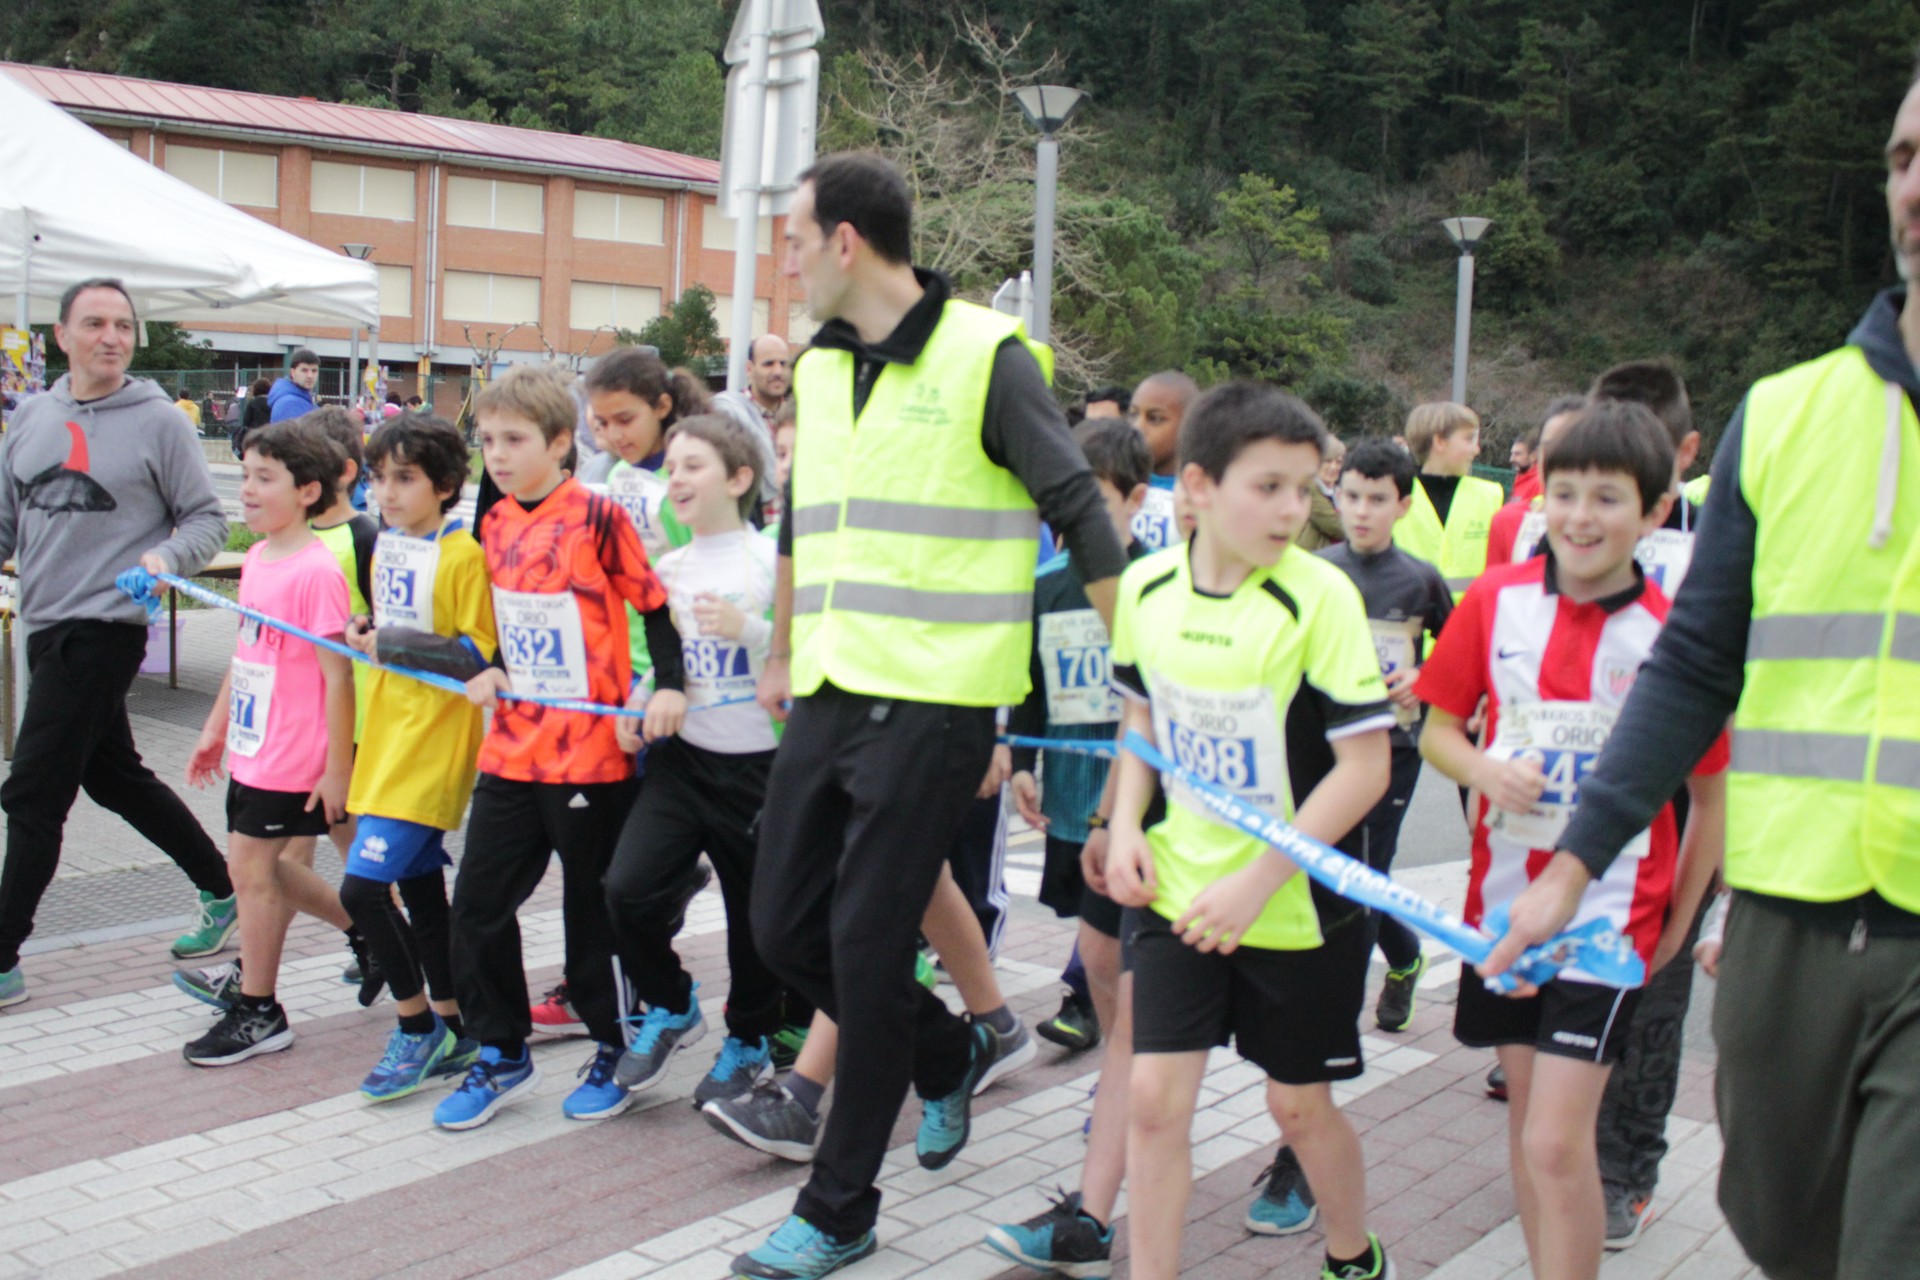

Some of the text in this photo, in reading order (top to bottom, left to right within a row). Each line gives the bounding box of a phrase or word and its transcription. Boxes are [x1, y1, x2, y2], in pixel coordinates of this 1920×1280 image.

[516, 610, 549, 627] ORIO
[504, 626, 558, 666] 632
[682, 639, 738, 681] 687
[1190, 709, 1239, 734] ORIO
[1172, 724, 1249, 789] 698
